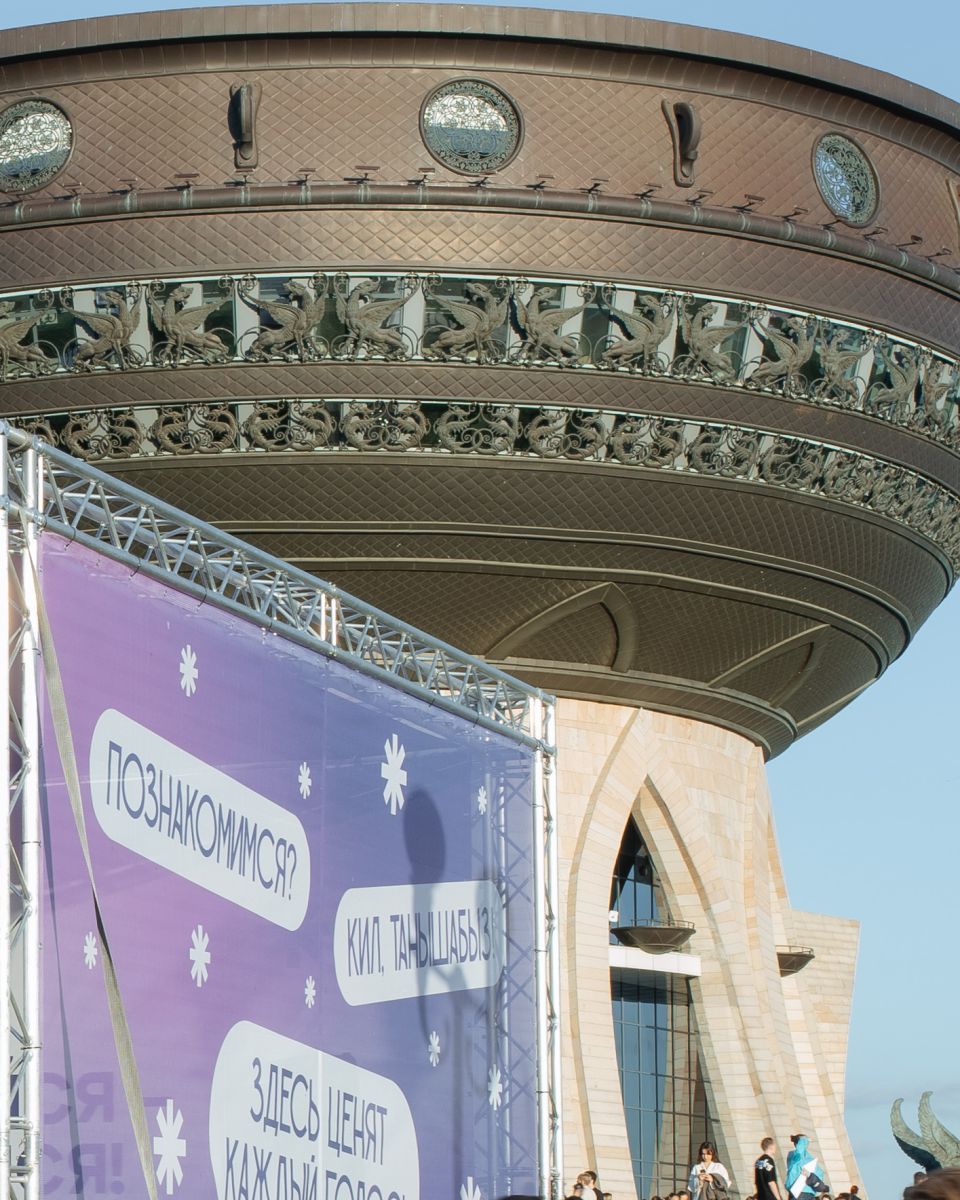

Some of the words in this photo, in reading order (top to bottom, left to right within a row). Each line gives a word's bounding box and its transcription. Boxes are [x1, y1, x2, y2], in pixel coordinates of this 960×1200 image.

[105, 740, 298, 901] ПОЗНАКОМИМСЯ?
[347, 916, 384, 977] КИЛ,
[251, 1057, 320, 1142] ЗДЕСЬ
[326, 1085, 387, 1166] ЦЕНЯТ
